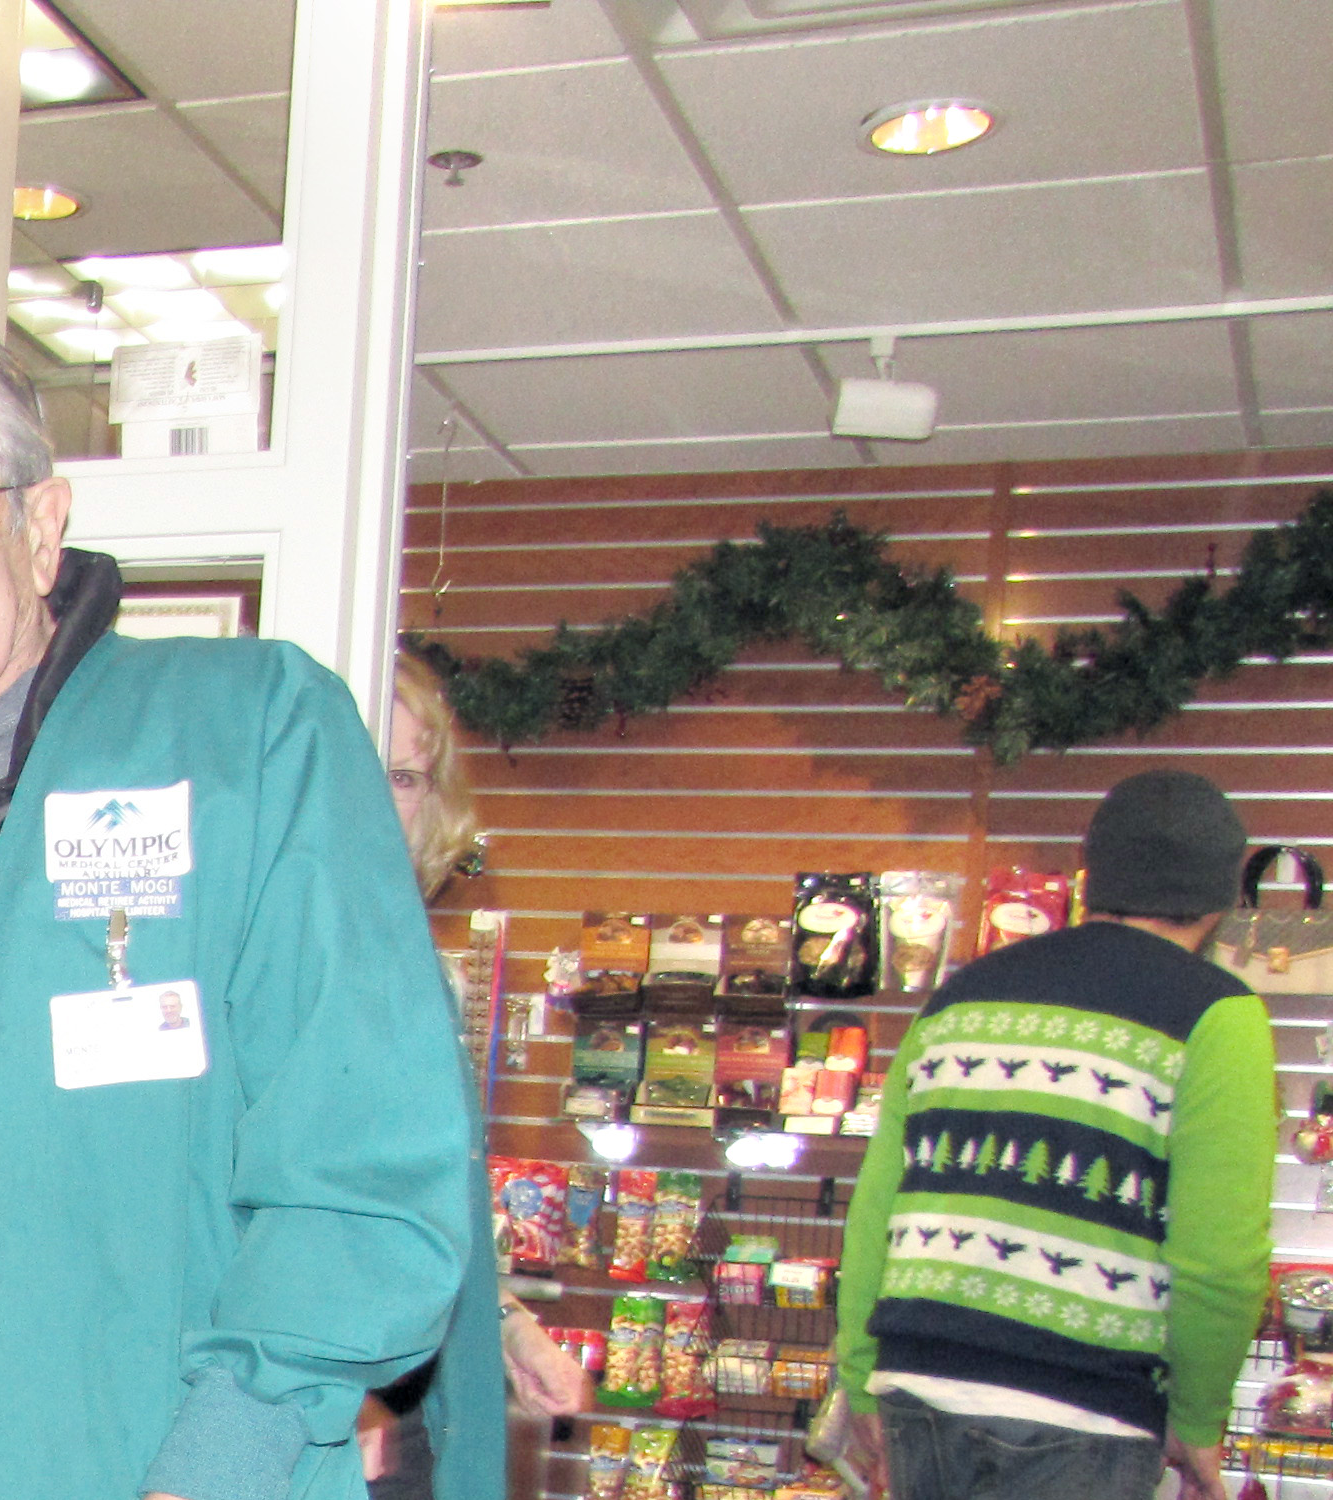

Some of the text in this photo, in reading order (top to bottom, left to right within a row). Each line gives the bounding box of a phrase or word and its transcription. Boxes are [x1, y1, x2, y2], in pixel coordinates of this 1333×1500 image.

[54, 829, 183, 859] OLYMPIC
[59, 851, 179, 870] MEDICAL CENTER
[81, 866, 161, 880] AUXILIARY
[60, 878, 174, 897] MONTE MOGI
